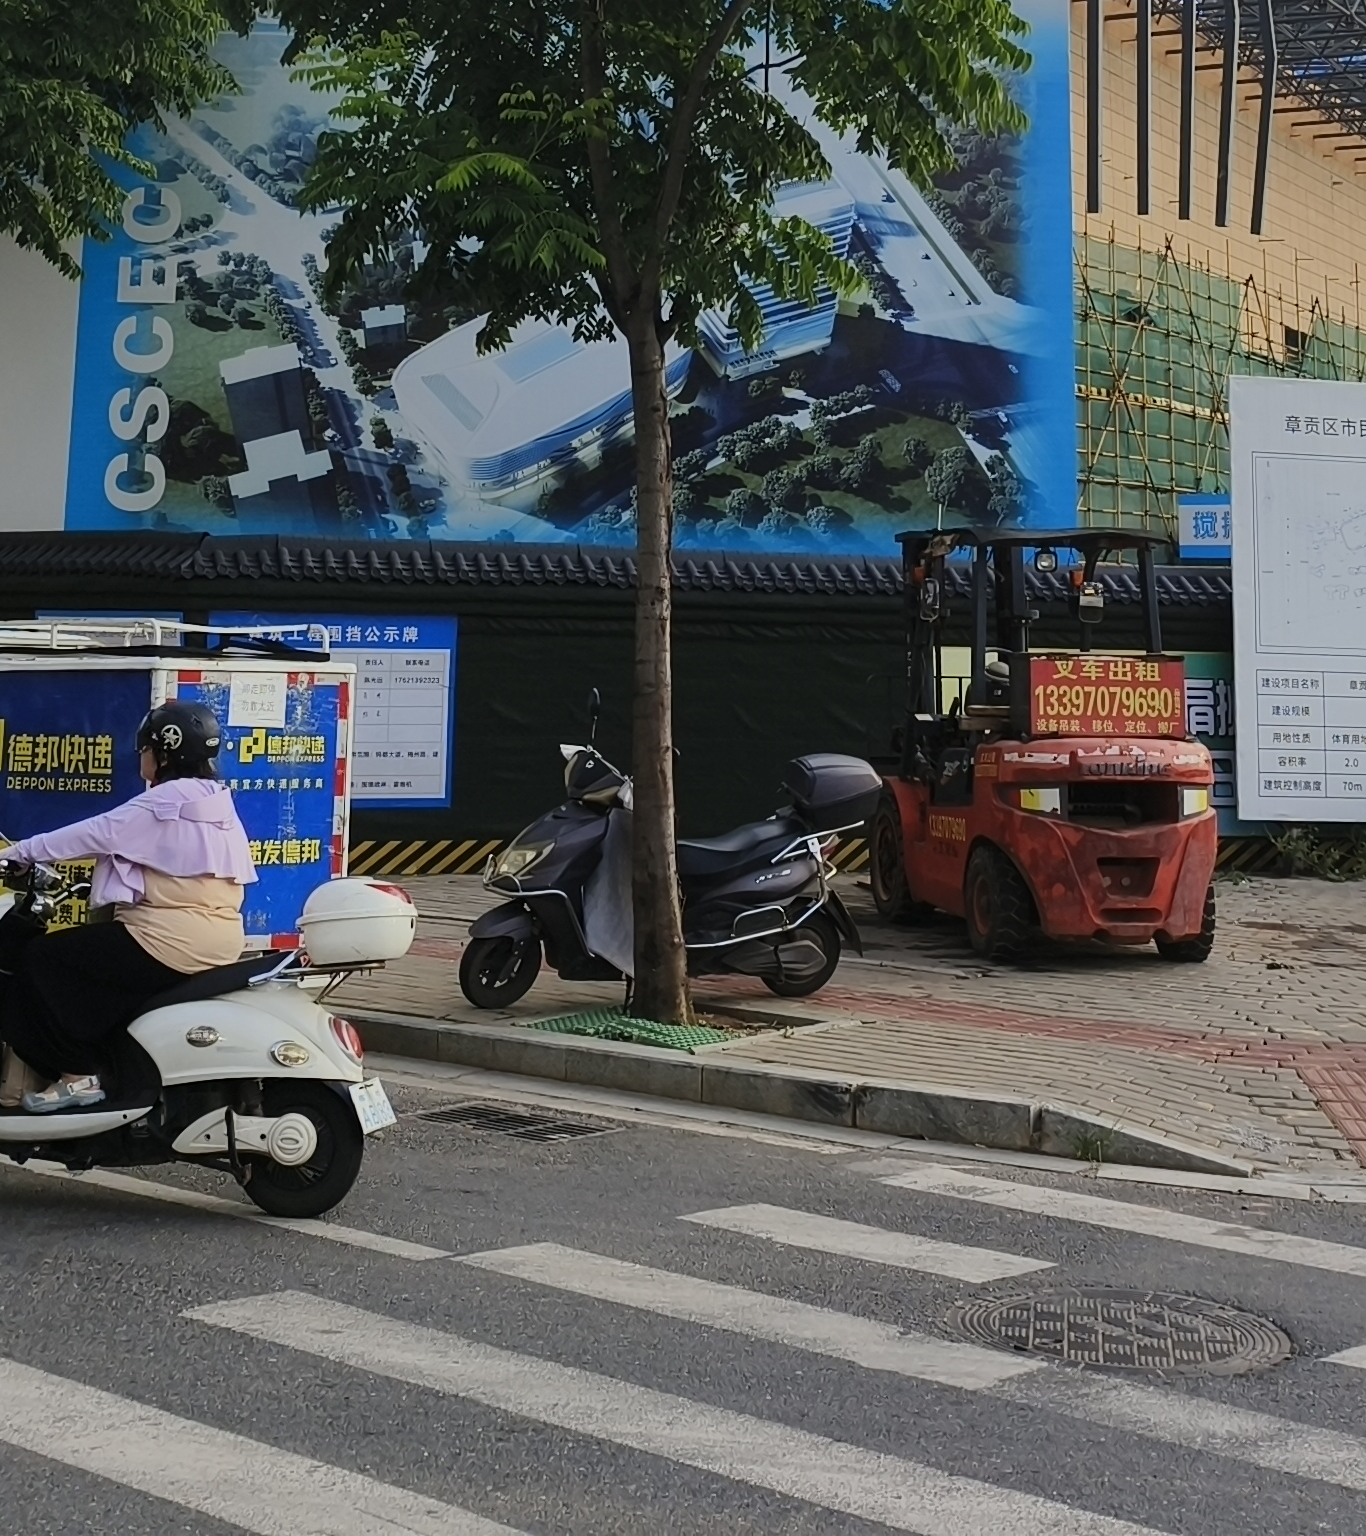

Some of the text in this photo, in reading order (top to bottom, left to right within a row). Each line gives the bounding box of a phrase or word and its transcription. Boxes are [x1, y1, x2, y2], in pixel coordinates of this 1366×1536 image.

[104, 186, 182, 513] CSCEC
[1051, 660, 1162, 682] 叉车出租
[1261, 677, 1321, 690] 建设项目名称
[1035, 685, 1173, 718] 13397079690
[1271, 705, 1311, 717] 建设规模
[1272, 732, 1312, 744] 用地性质
[7, 733, 113, 774] 德邦快递
[1277, 756, 1307, 767] 容积率
[1344, 758, 1359, 768] 2.0
[6, 776, 112, 793] DEPPON EXPRESS
[1263, 779, 1322, 792] 建筑控制高度
[1343, 781, 1363, 792] 70m
